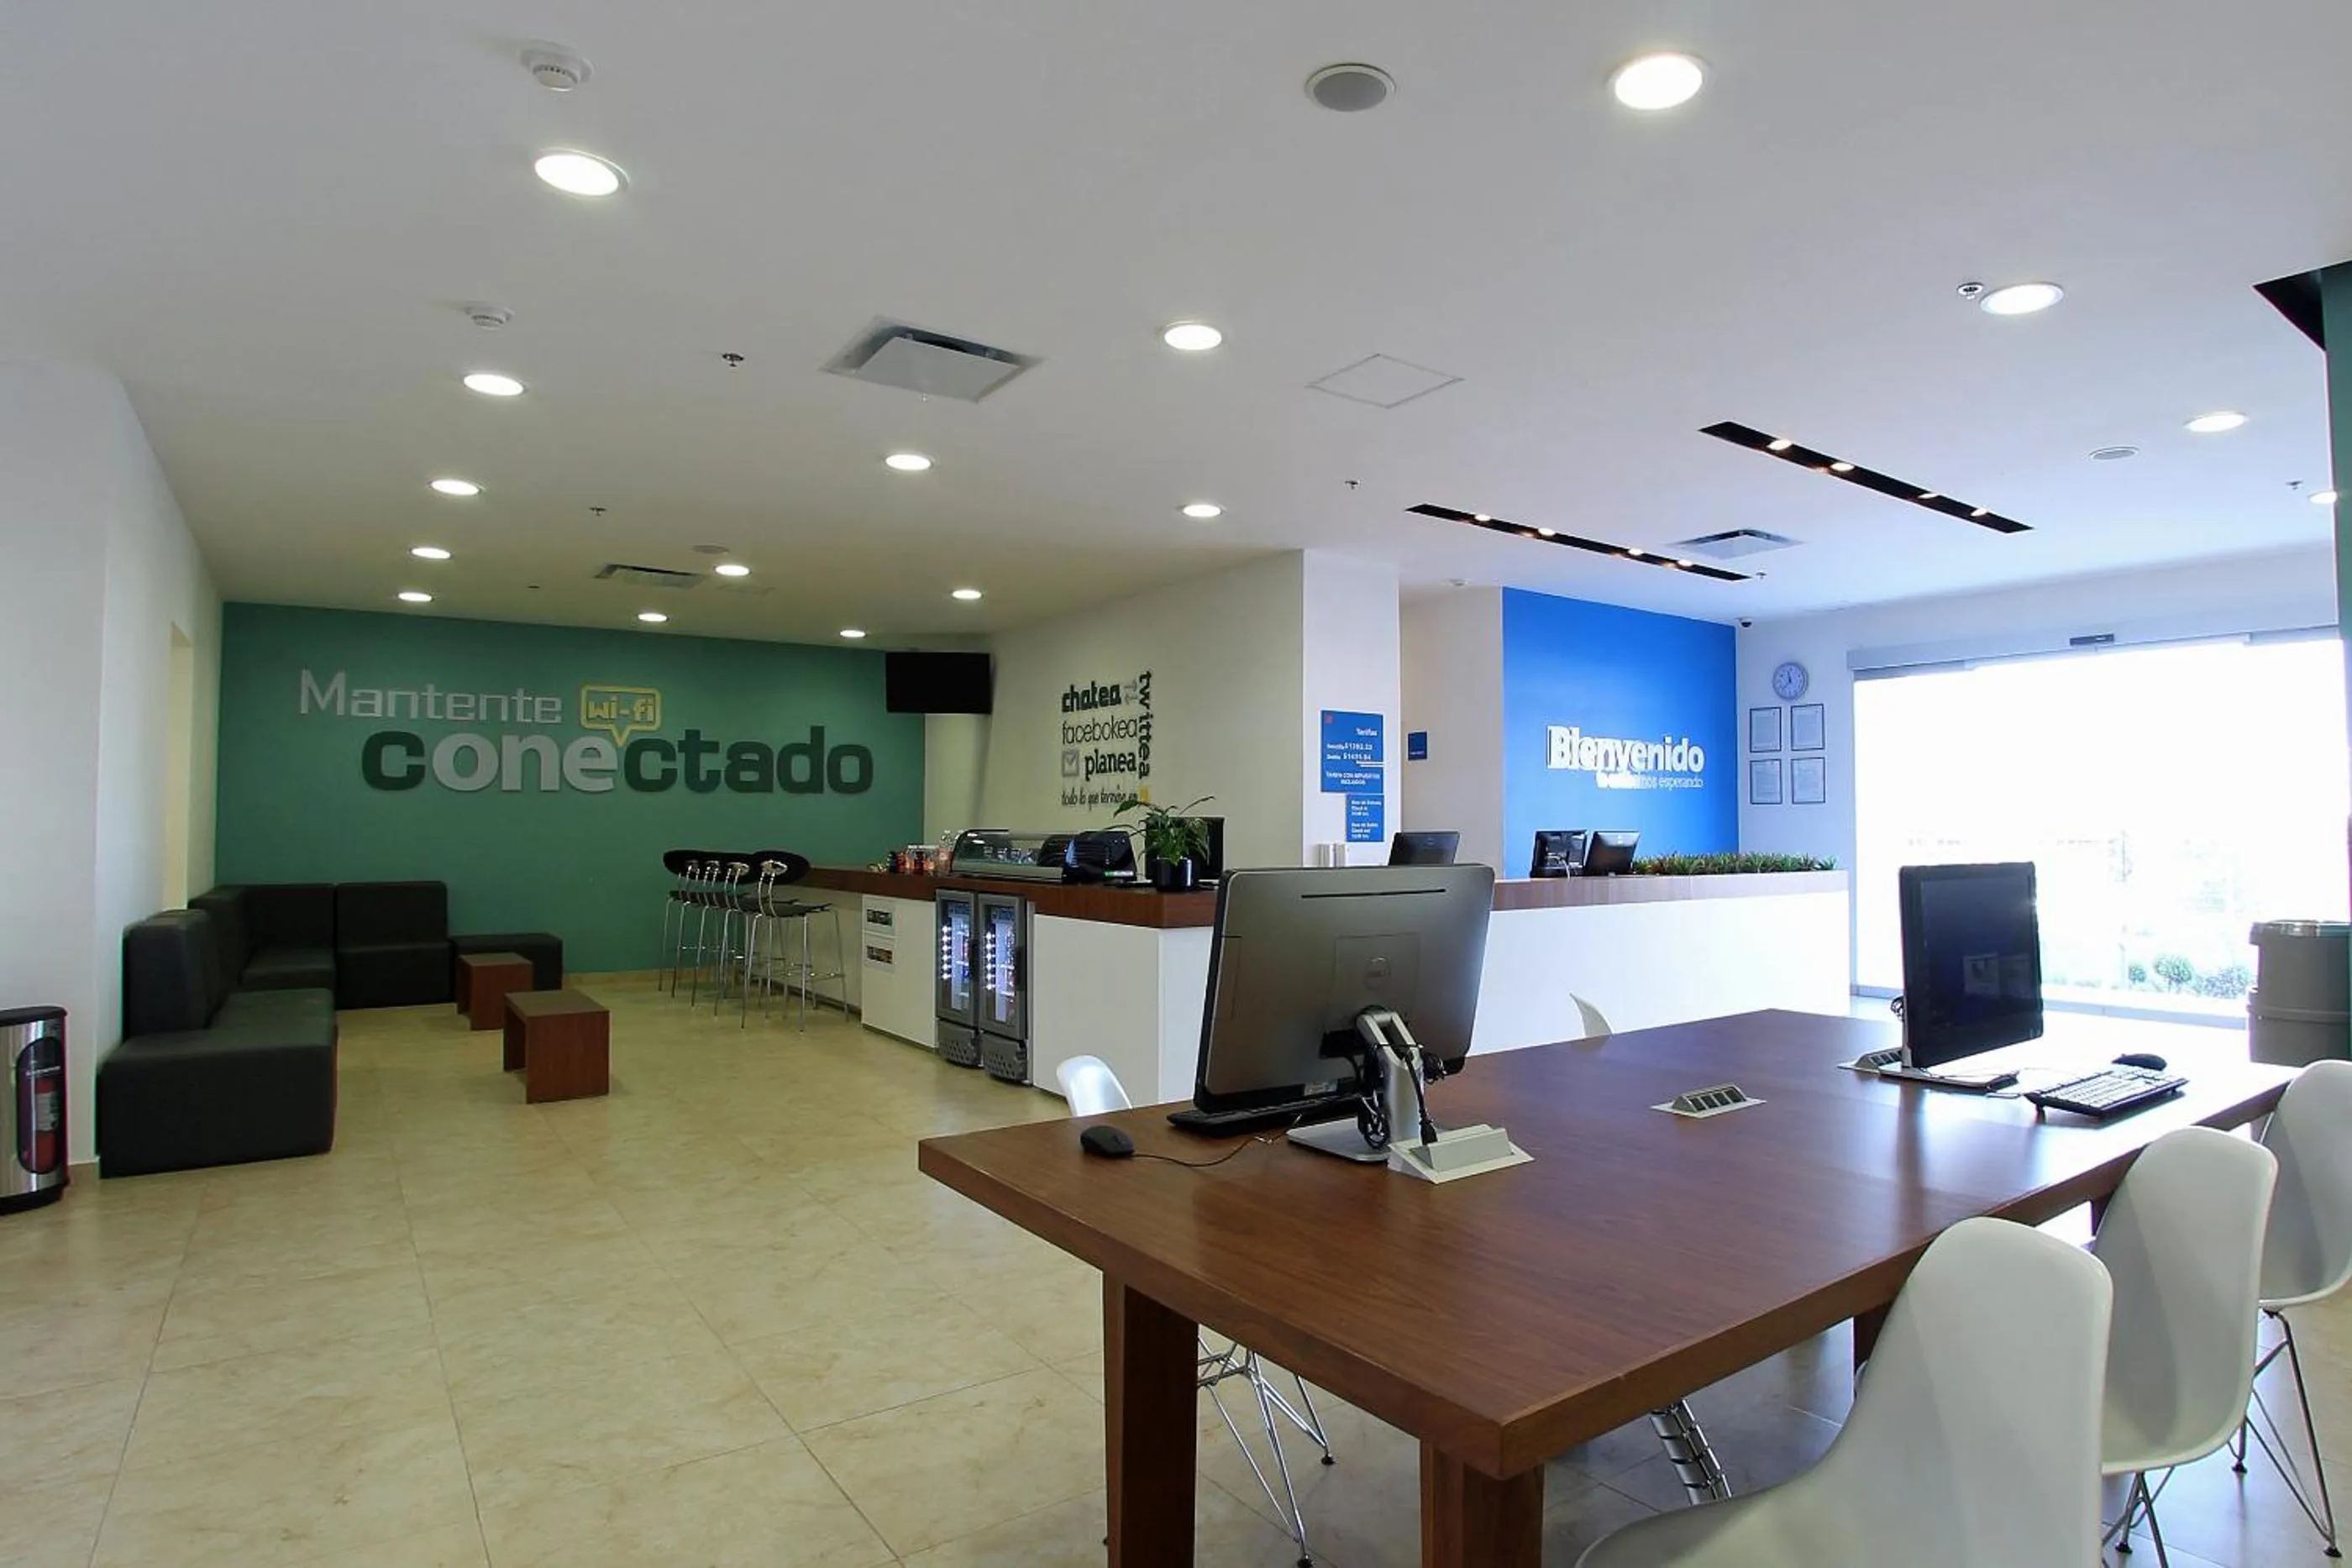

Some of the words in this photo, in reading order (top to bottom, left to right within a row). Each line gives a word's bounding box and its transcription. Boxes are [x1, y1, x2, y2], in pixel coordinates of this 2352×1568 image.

[298, 669, 563, 725] Mantente
[586, 695, 657, 722] wi-fi
[1062, 680, 1121, 712] chatea
[1138, 671, 1153, 779] twittea
[1547, 725, 1704, 774] Bienvenido
[361, 726, 874, 794] conectado
[1084, 749, 1137, 782] planea
